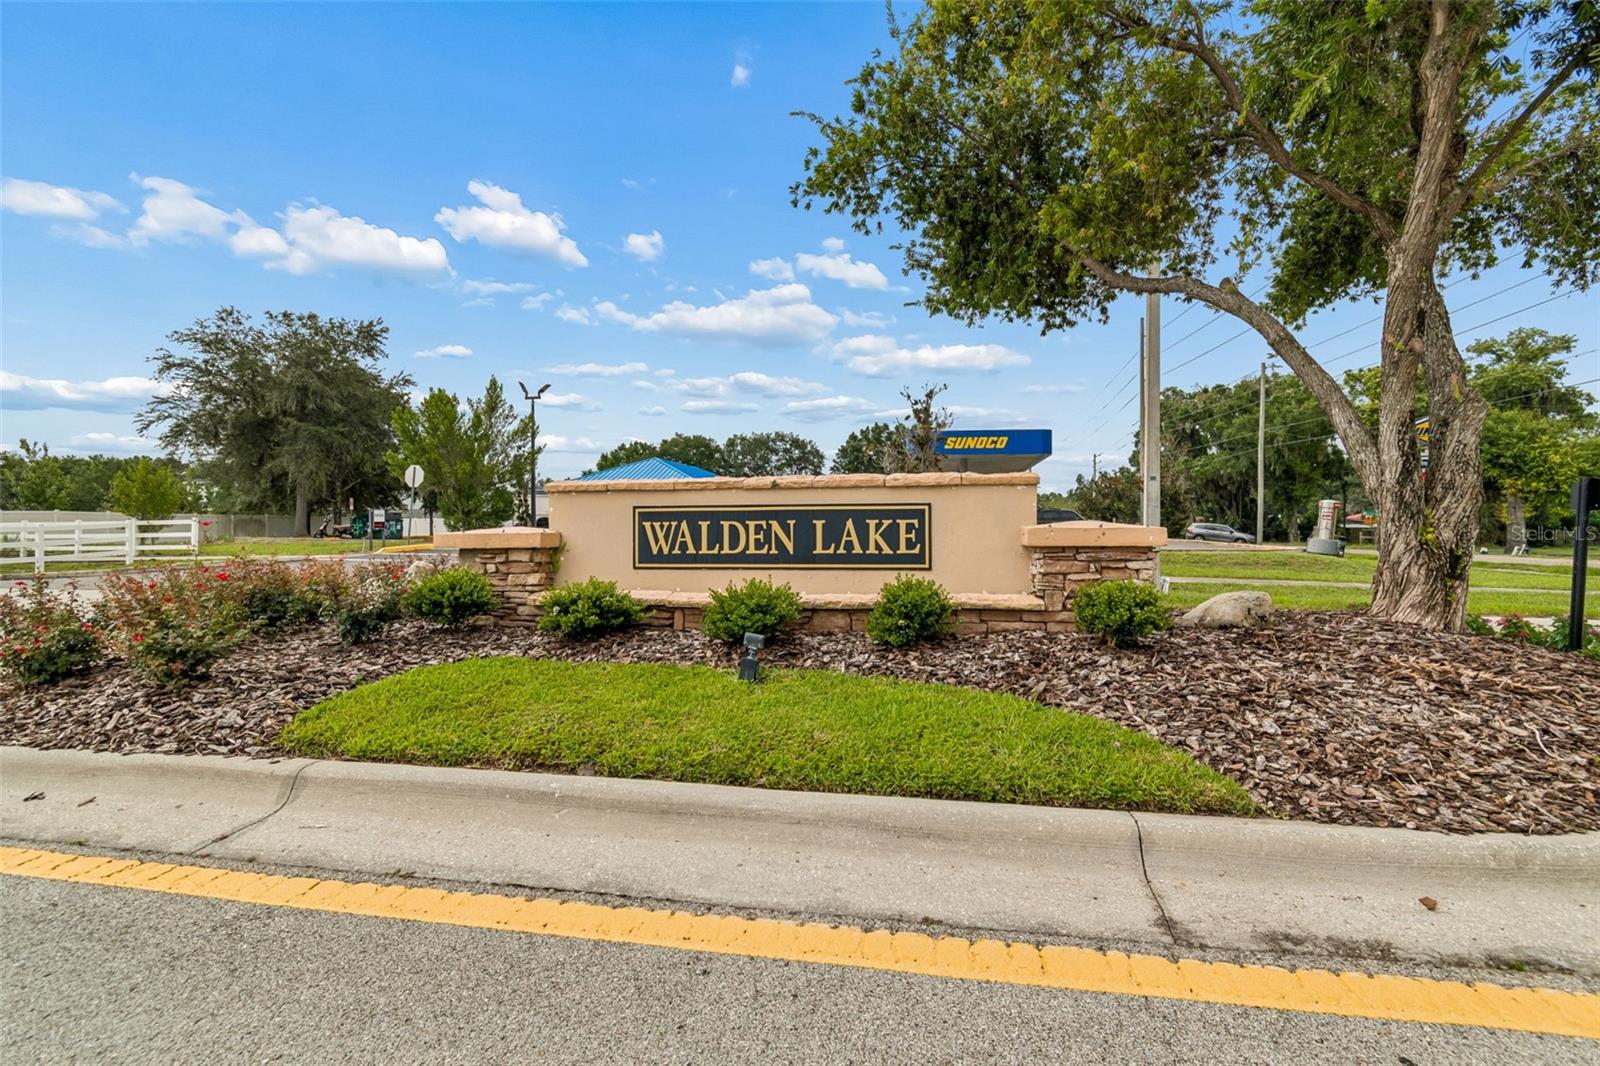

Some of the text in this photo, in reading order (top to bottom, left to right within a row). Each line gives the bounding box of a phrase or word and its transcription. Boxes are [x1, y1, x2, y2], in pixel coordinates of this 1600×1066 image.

[944, 436, 1008, 449] SUNOCO
[642, 518, 921, 555] WALDEN LAKE
